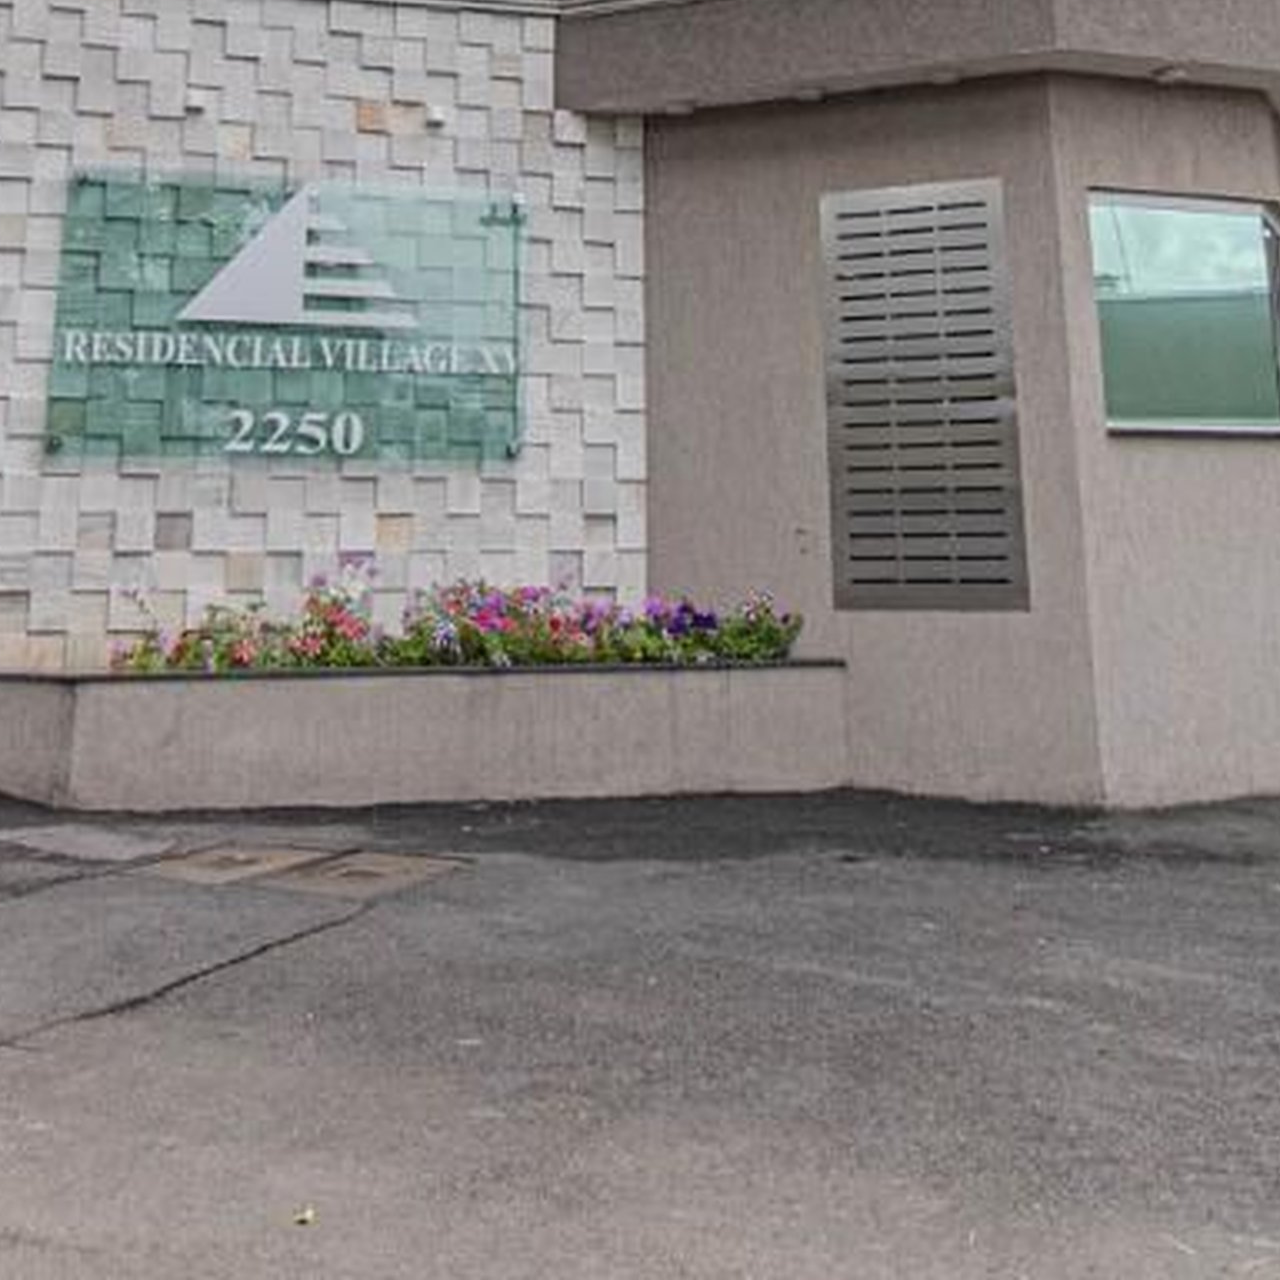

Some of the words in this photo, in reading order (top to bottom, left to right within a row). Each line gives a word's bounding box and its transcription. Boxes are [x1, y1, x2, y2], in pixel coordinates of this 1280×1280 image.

[63, 329, 312, 368] RESIDENCIAL
[320, 337, 463, 373] VILLAGE
[223, 410, 364, 455] 2250
